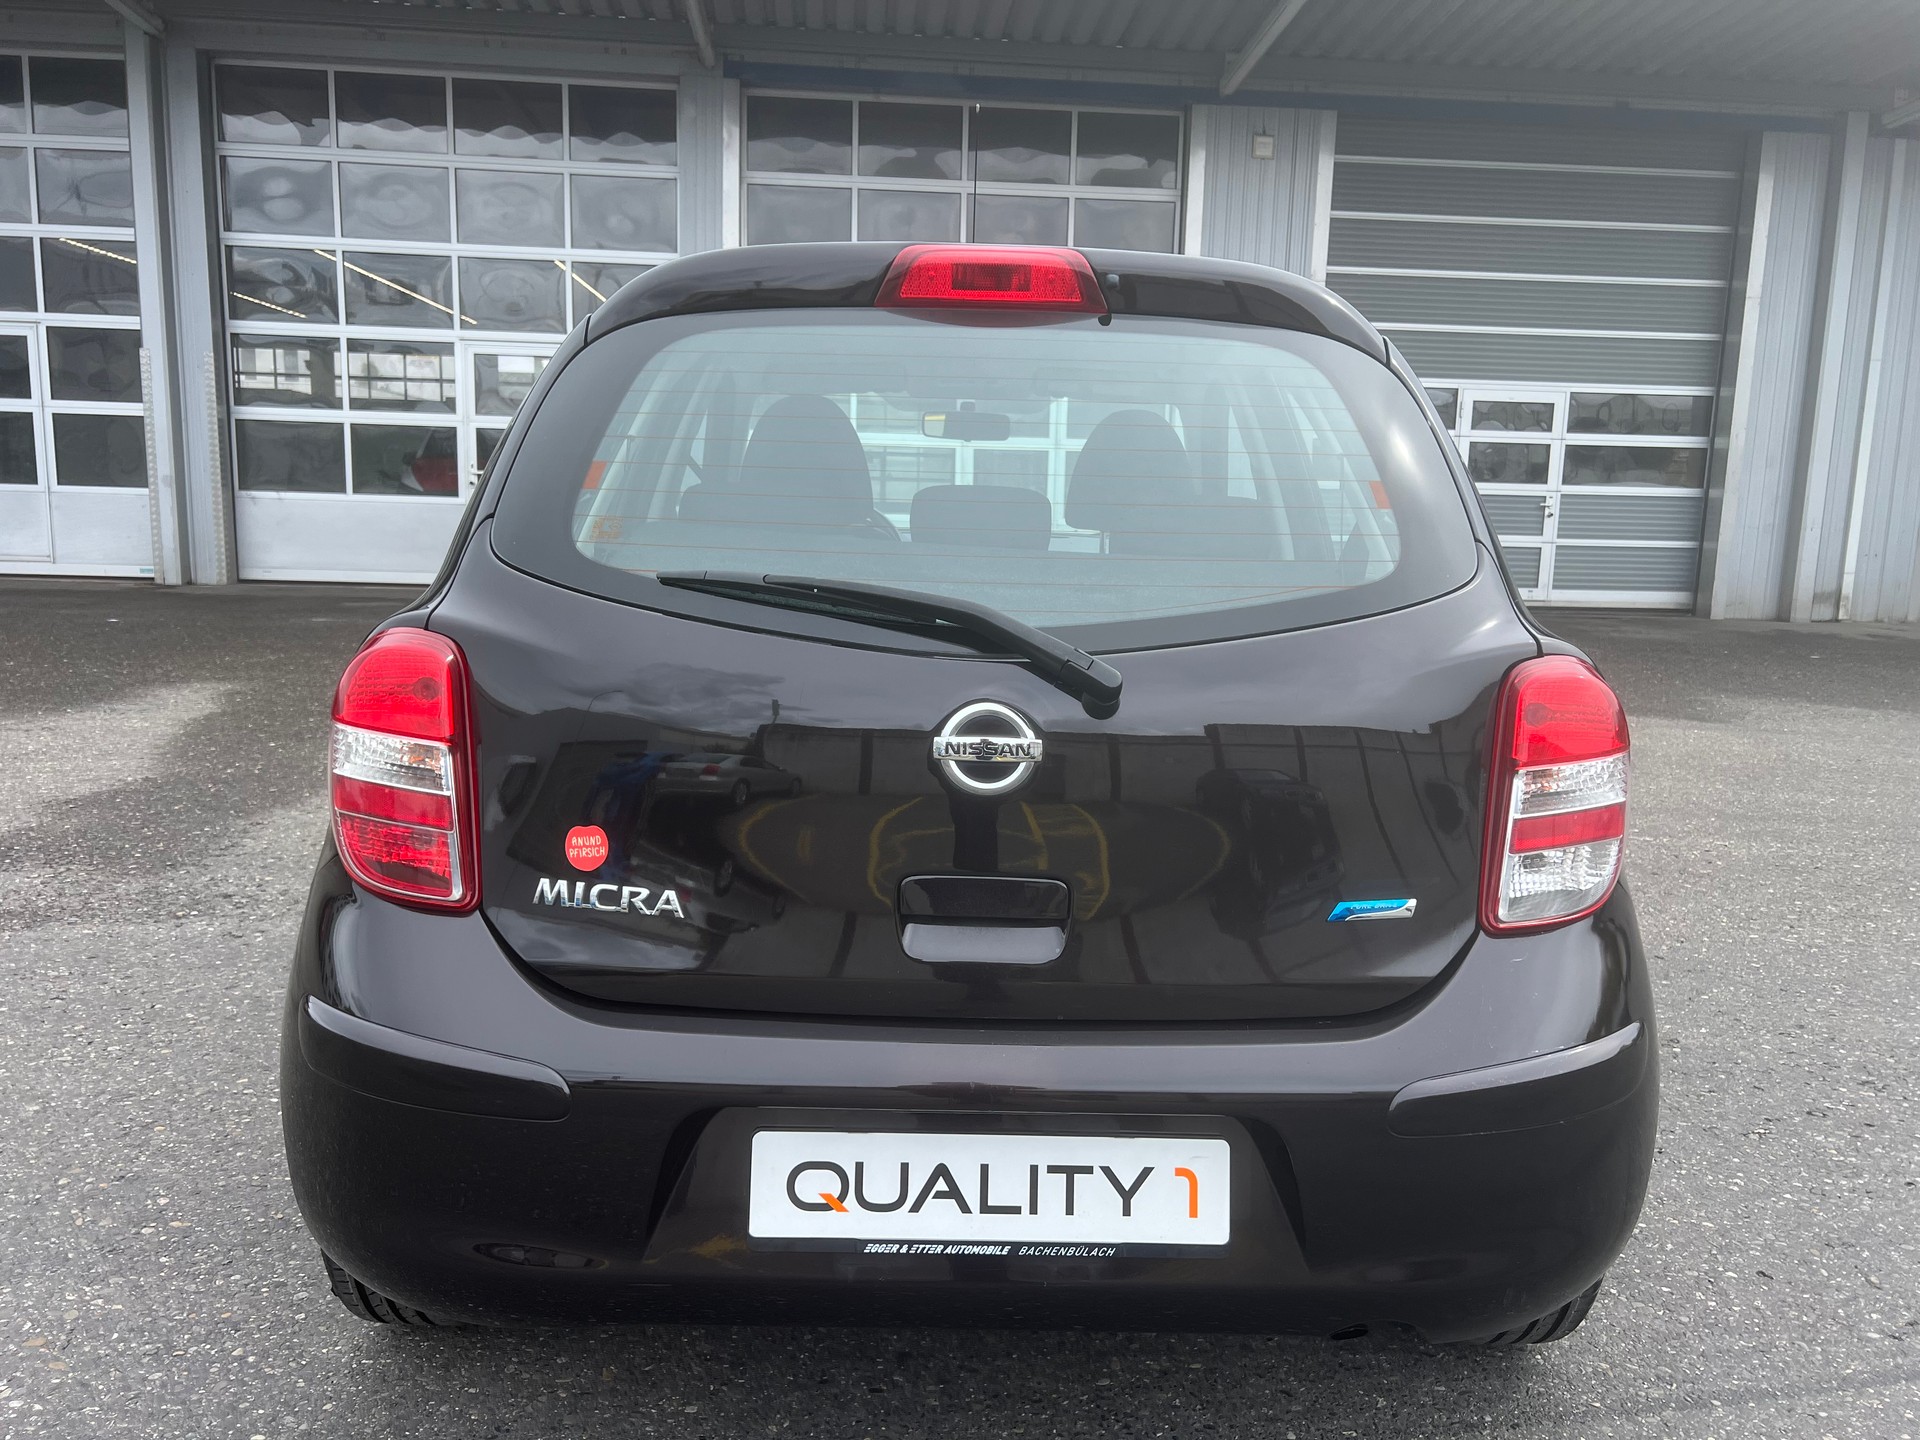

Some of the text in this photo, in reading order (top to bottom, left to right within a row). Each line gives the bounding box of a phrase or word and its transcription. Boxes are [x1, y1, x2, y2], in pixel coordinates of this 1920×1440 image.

[944, 741, 1031, 757] NISSAN
[569, 846, 606, 858] PFIRSICH
[532, 877, 685, 919] MICRA
[786, 1160, 1199, 1219] QUALITY 1
[863, 1243, 1117, 1258] EGGER & ETTER AUTOMOBILE BACHENBÜLACH
